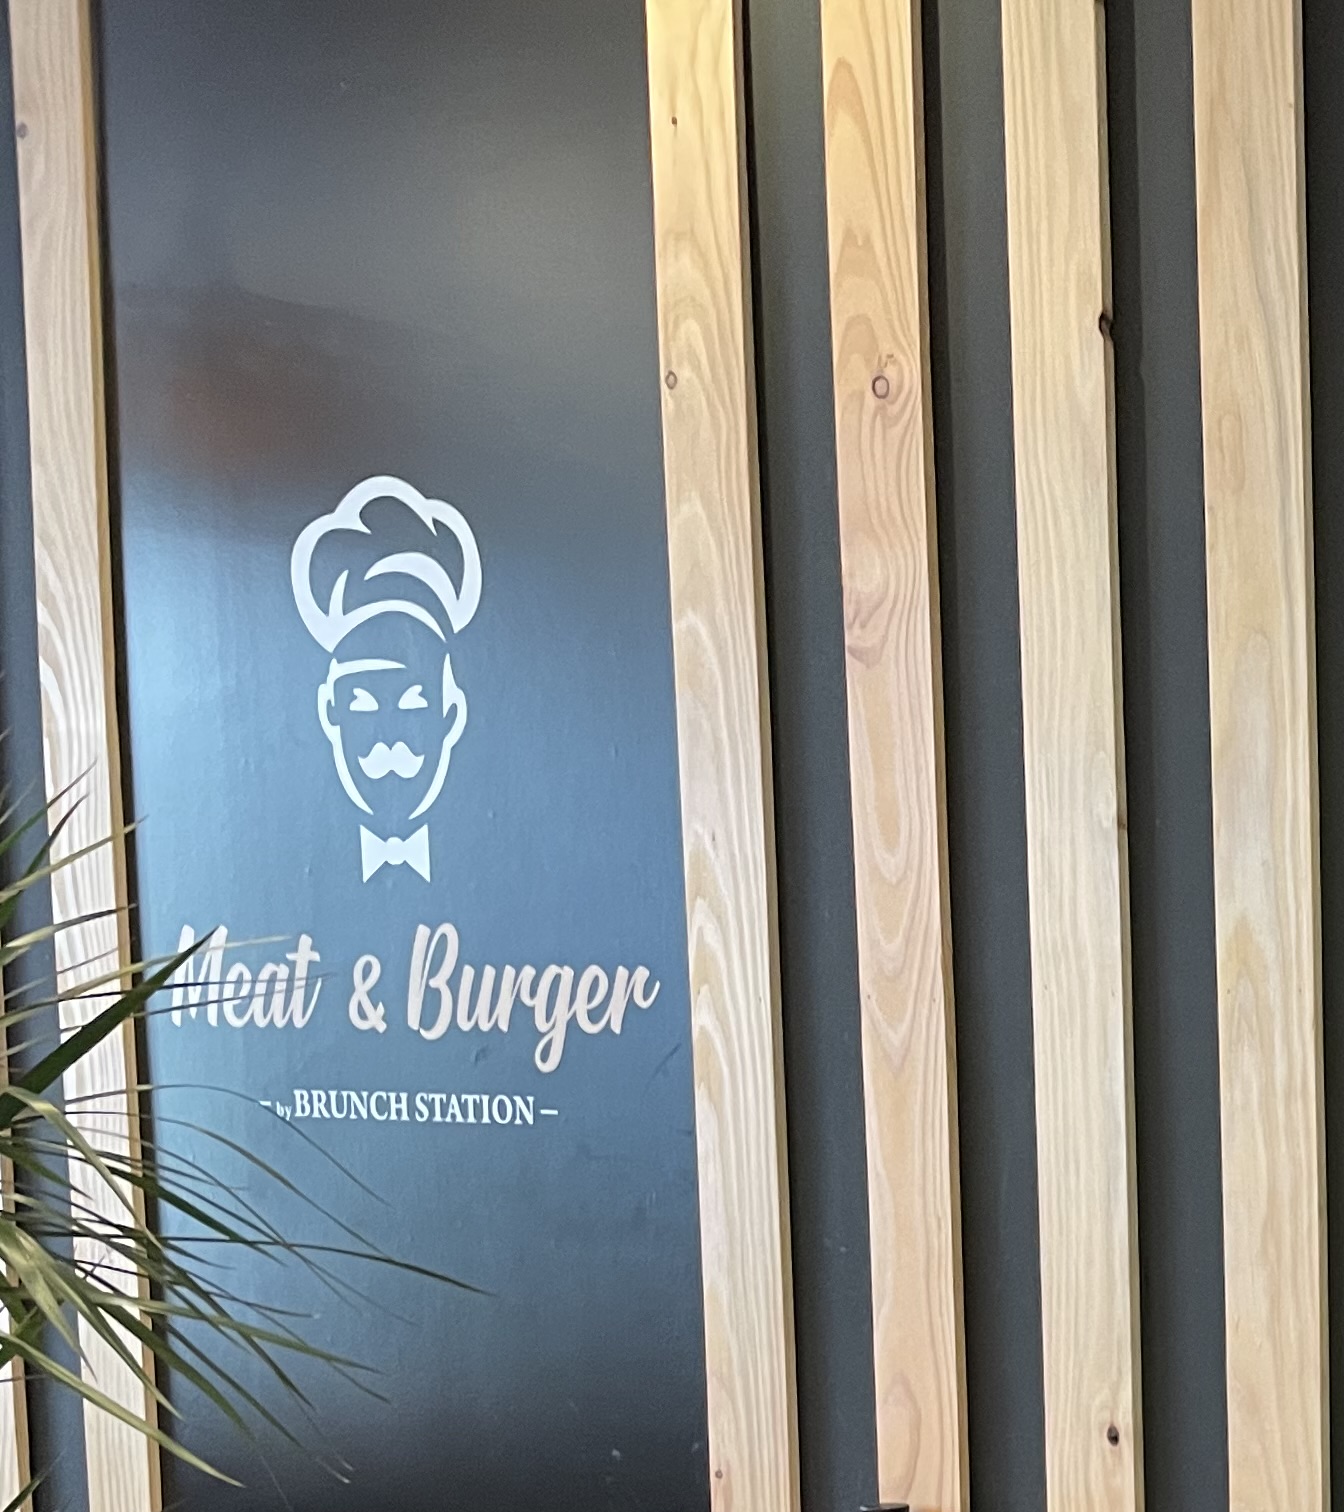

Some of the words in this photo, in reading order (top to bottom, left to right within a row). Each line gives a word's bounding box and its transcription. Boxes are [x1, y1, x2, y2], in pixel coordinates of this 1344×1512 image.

[171, 923, 323, 1029] Meat
[349, 954, 388, 1034] &
[407, 922, 661, 1073] Burger
[275, 1101, 293, 1121] by
[293, 1089, 410, 1121] BRUNCH
[415, 1092, 535, 1126] STATION
